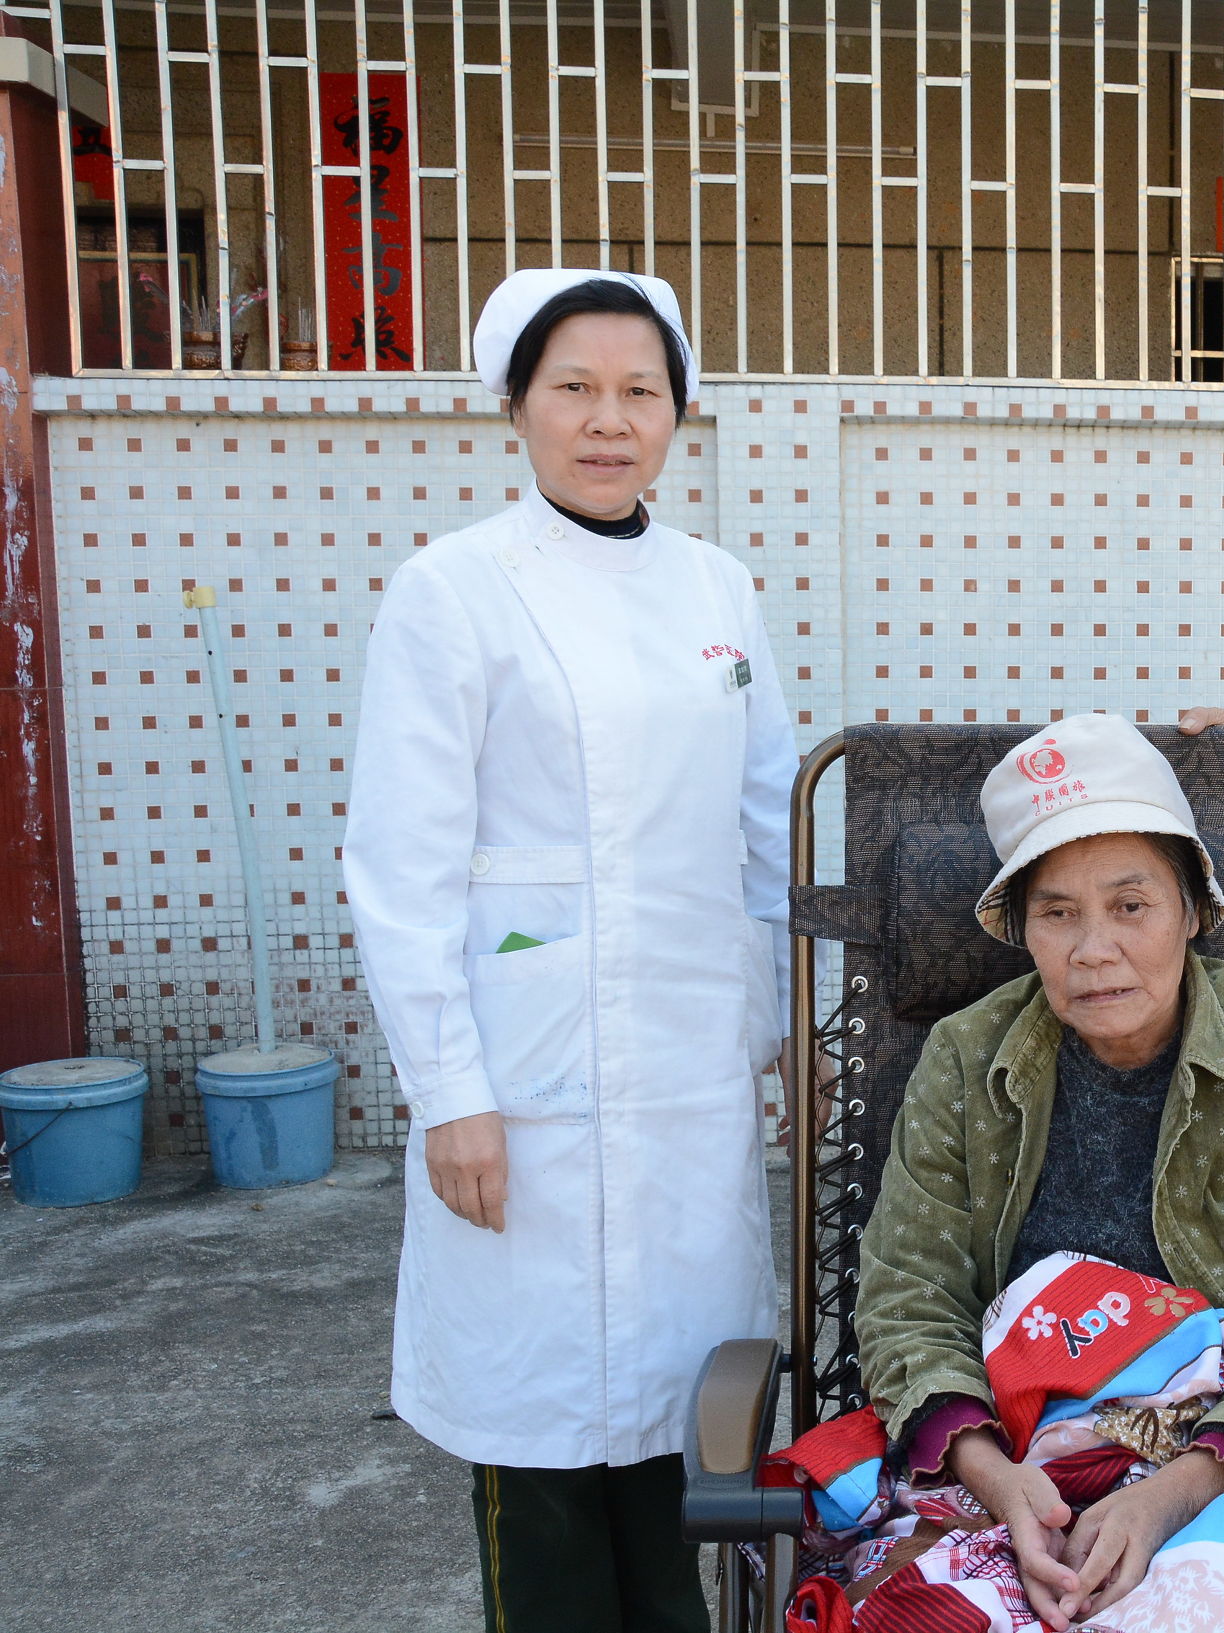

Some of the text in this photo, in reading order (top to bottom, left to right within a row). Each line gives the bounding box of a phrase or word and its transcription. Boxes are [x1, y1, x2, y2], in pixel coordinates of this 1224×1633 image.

[333, 95, 411, 362] 福星高照
[1060, 1291, 1131, 1359] day
